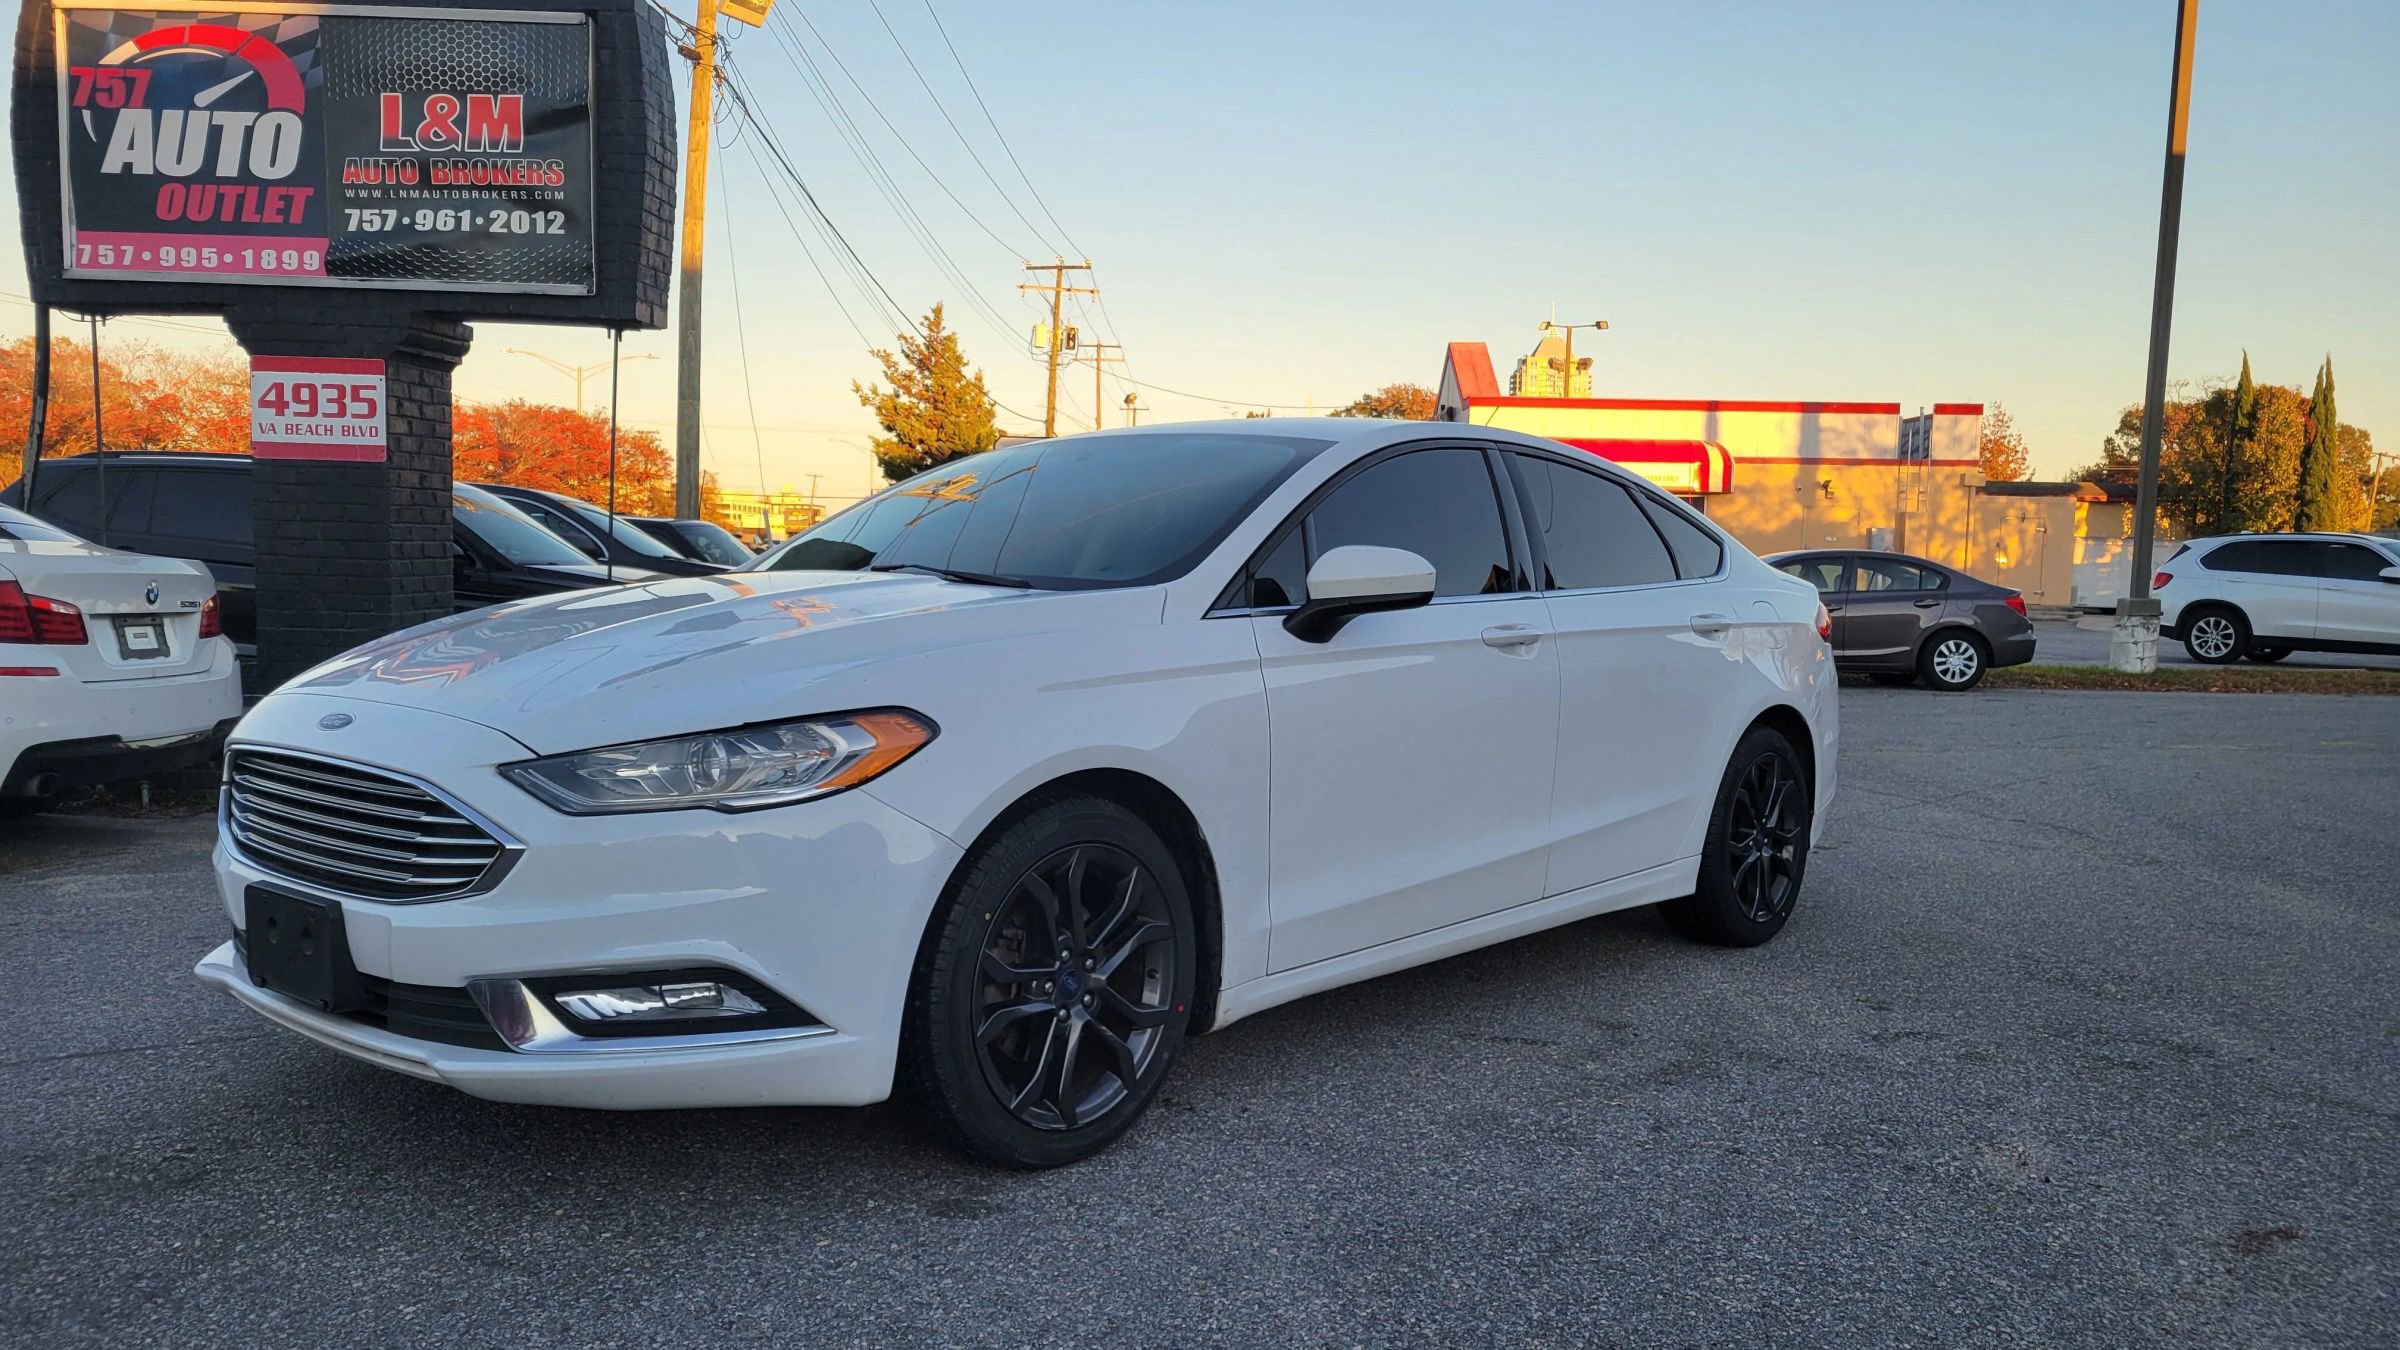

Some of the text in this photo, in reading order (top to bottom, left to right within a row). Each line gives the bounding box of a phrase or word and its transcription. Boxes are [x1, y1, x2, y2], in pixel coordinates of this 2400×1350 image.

[70, 66, 152, 109] 757
[380, 92, 524, 153] L&M
[100, 108, 303, 180] AUTO
[342, 157, 565, 187] AUTO BROKERS
[155, 182, 315, 225] OUTLET
[345, 188, 565, 200] WWW.LNMAUTOBROKERS.COM
[257, 381, 378, 420] 4935
[258, 422, 379, 438] VA BEACH BLVD
